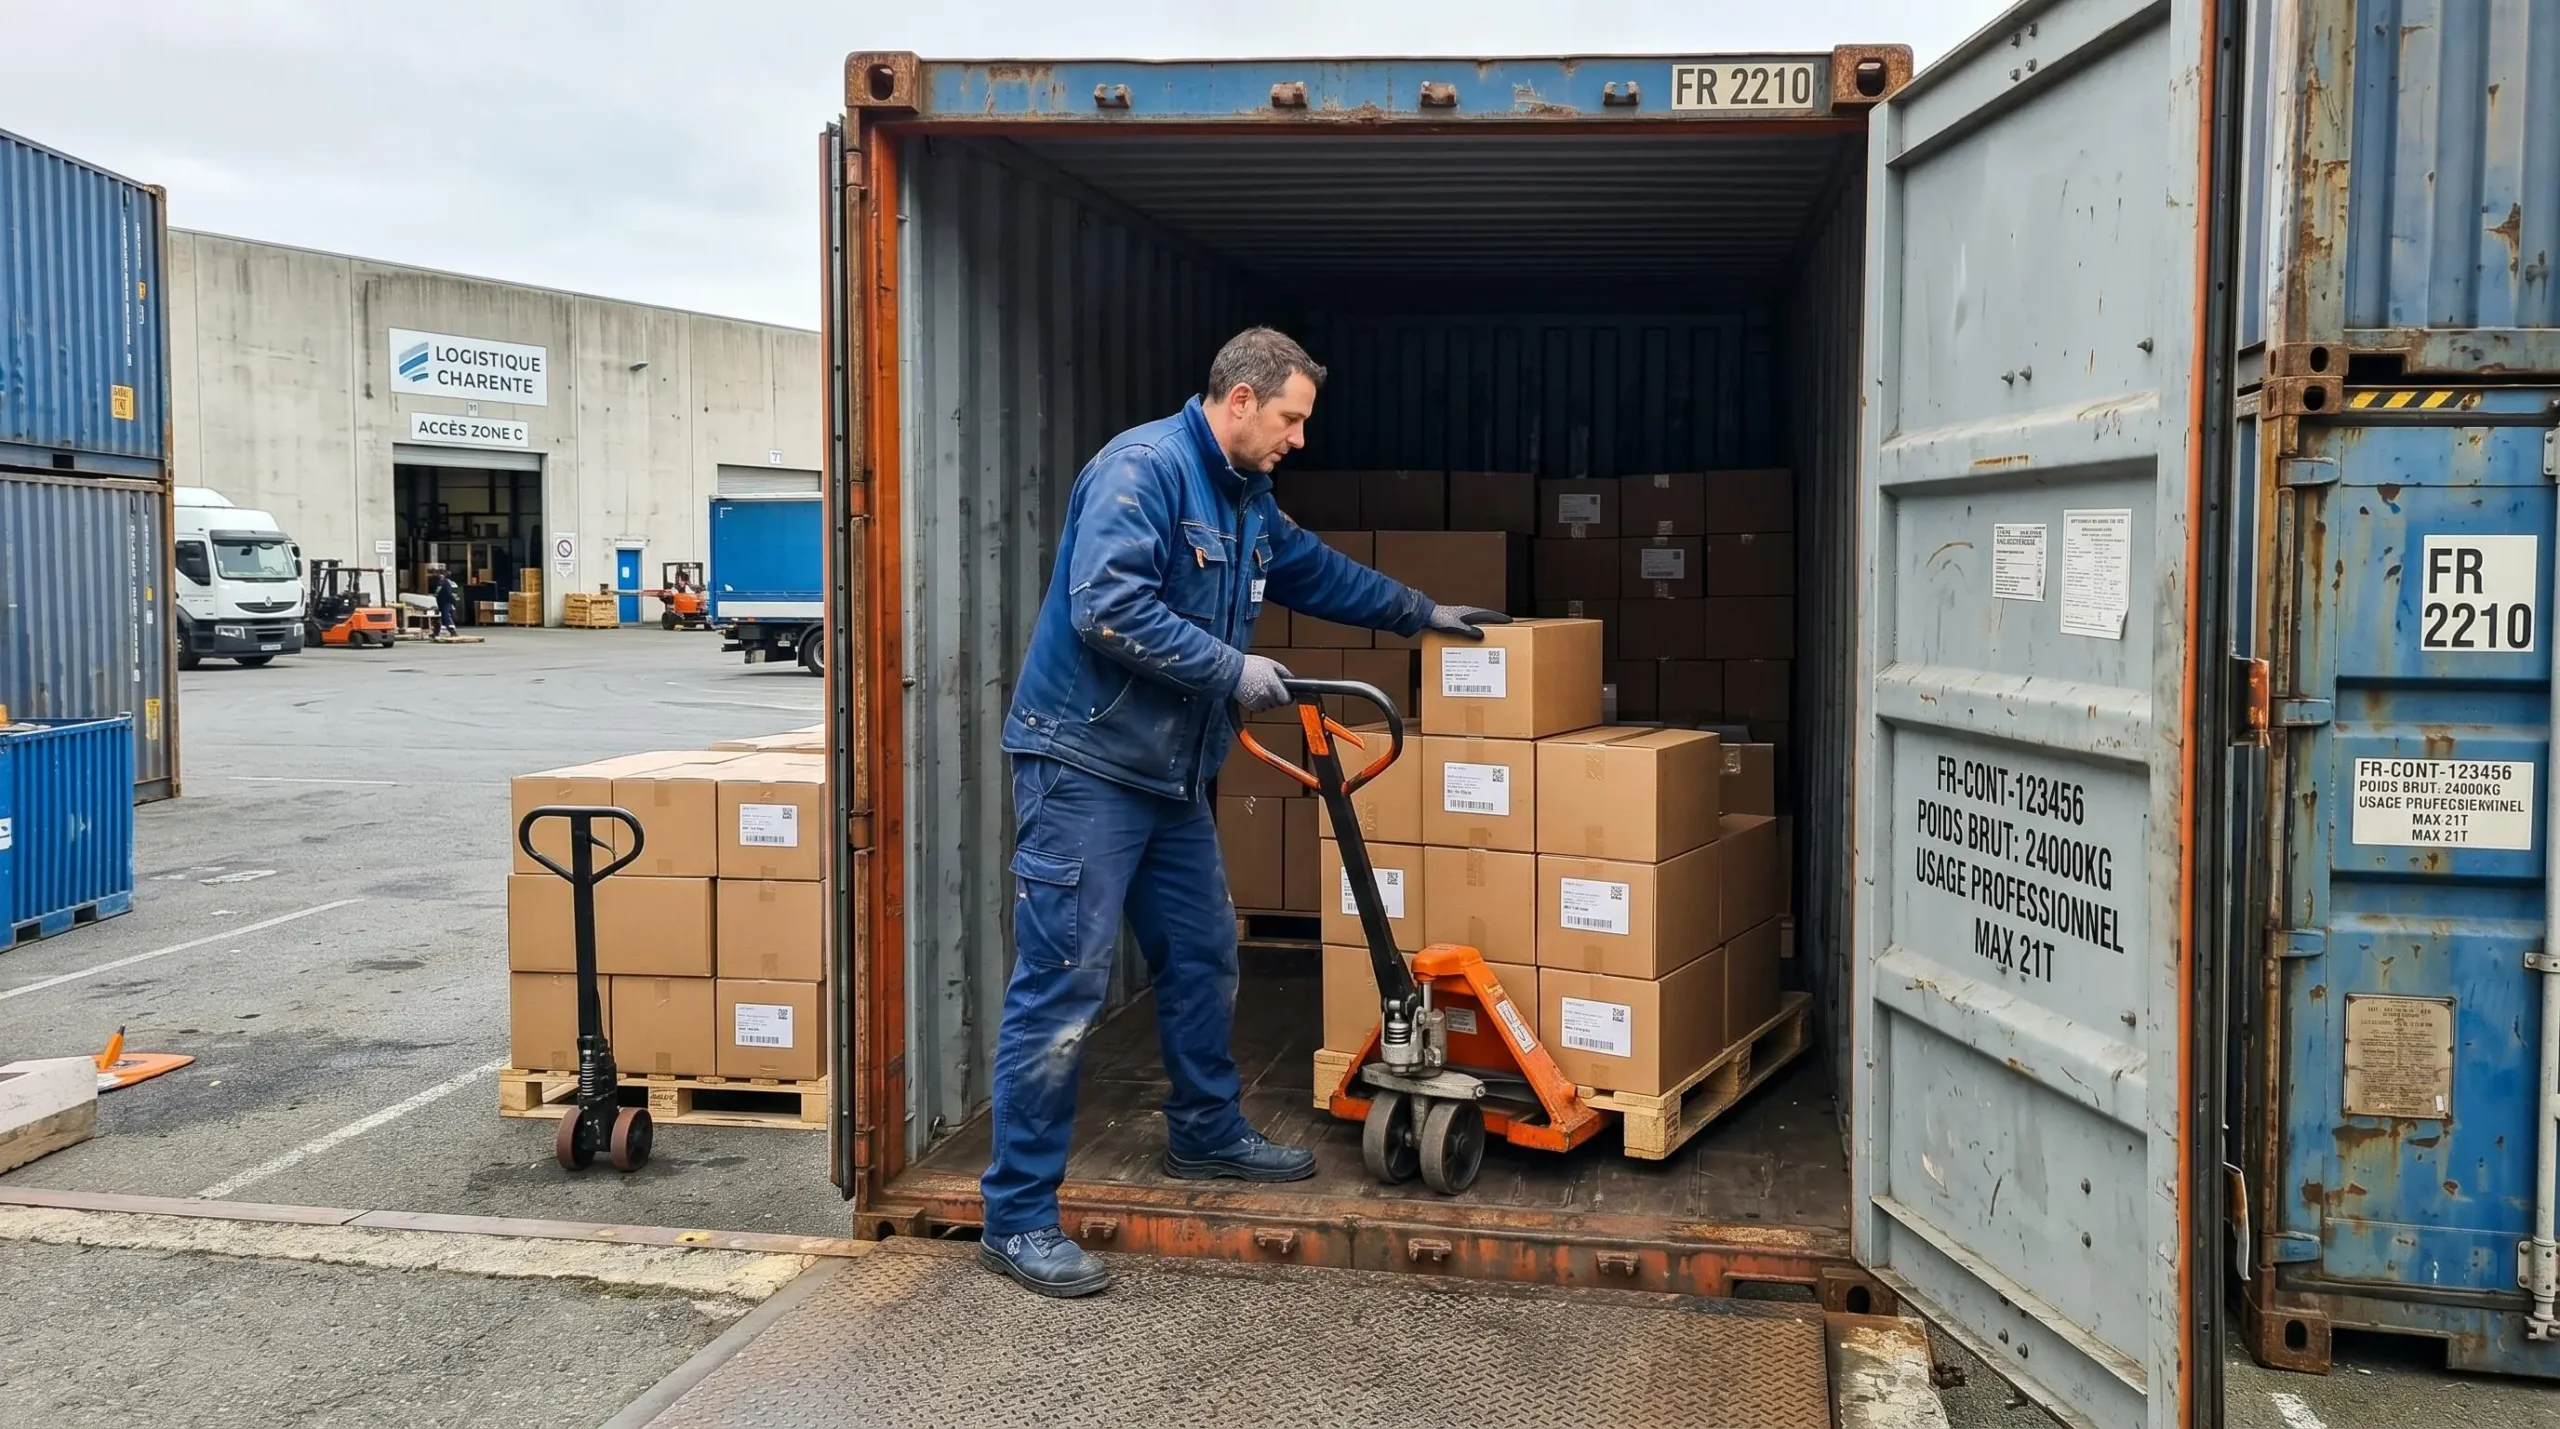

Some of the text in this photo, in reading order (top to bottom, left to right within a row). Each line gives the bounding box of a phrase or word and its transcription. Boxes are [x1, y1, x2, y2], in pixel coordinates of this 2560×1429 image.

[1676, 67, 1810, 105] FR 2210
[436, 345, 541, 373] LOGISTIQUE
[437, 369, 533, 394] CHARENTE
[418, 420, 523, 441] ACCÈS ZONE C
[2428, 548, 2484, 594] FR
[2424, 602, 2532, 649] 2210
[2360, 760, 2512, 781] FR-CONT-123456
[1937, 754, 2084, 826] FR-CONT-123456
[2359, 780, 2501, 796] POIDS BRUT: 24000KG
[2411, 829, 2469, 842] MAX 21T
[2412, 813, 2469, 826] MAX 21T
[1917, 798, 2112, 892] POIDS BRUT: 24000KG
[1916, 846, 2124, 954] USAGE PROFESSIONNEL
[1975, 917, 2055, 983] MAX 21T
